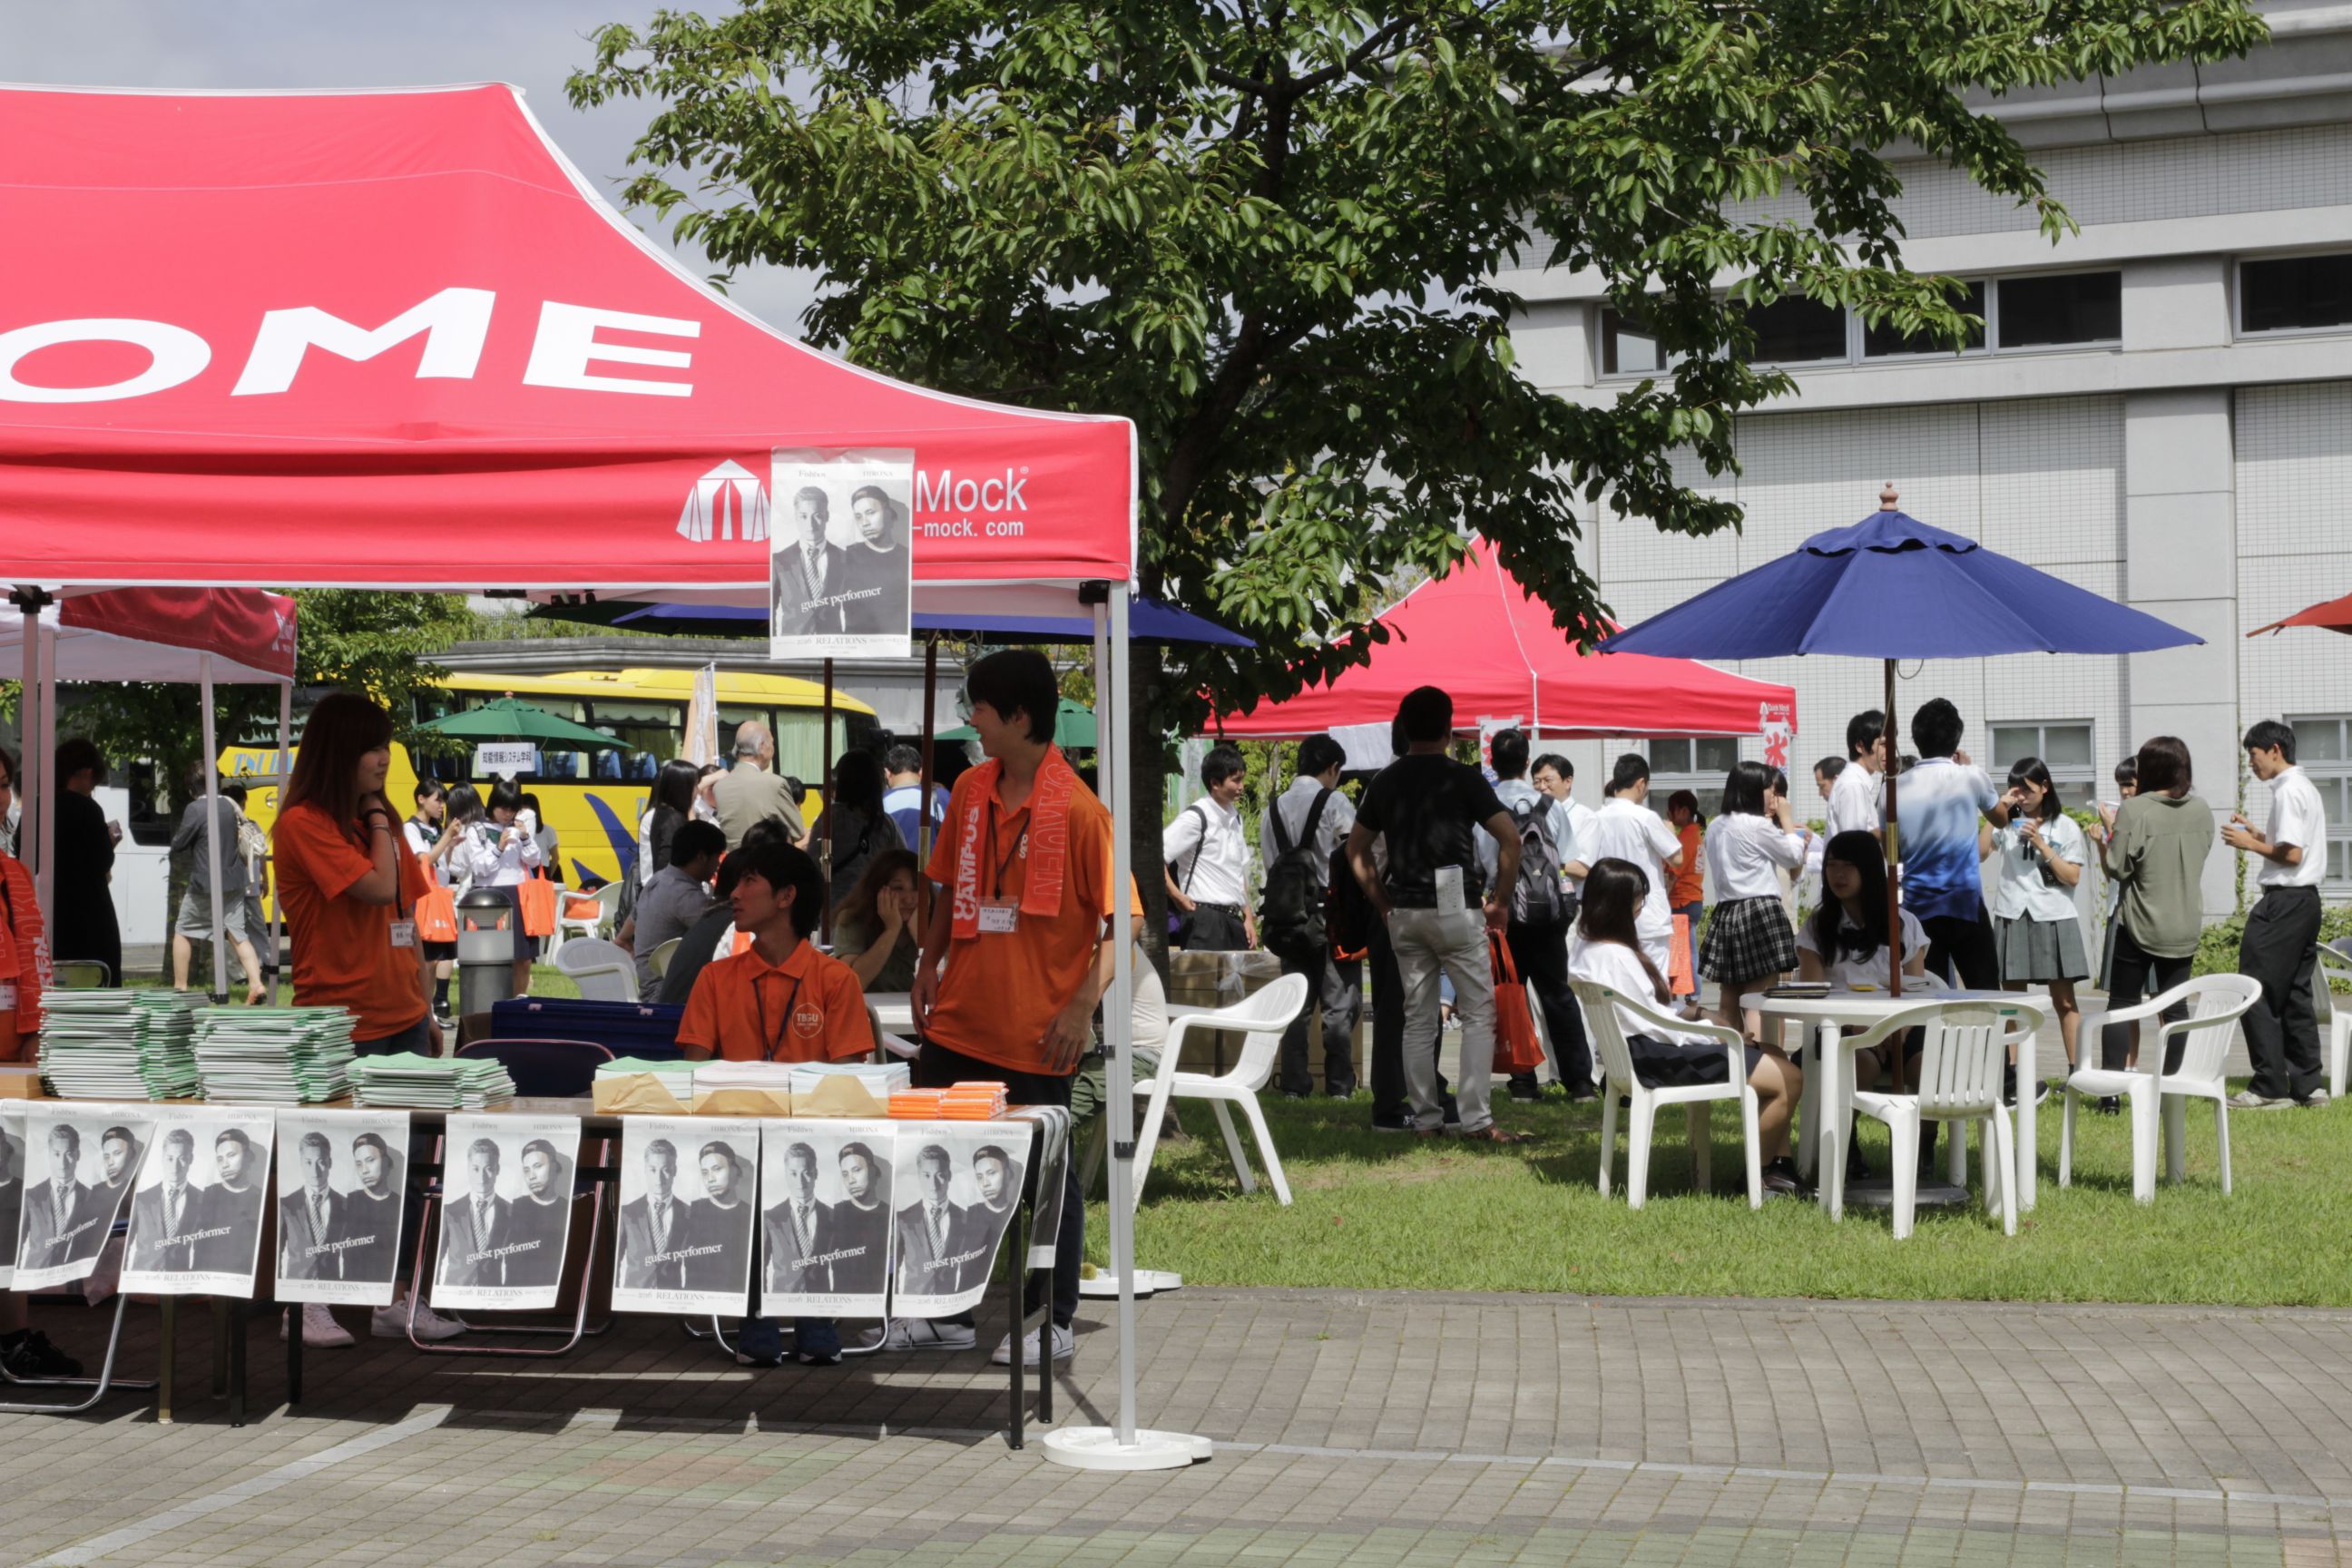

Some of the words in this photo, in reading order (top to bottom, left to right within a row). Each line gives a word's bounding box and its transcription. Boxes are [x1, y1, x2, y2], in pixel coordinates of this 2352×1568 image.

[801, 595, 829, 612] guest
[830, 587, 882, 606] performer
[817, 637, 867, 645] RELATIONS
[45, 1232, 66, 1248] guest
[66, 1217, 99, 1240] performer
[154, 1234, 181, 1250] guest
[183, 1227, 231, 1245] performer
[305, 1243, 330, 1258] guest
[331, 1235, 376, 1253] performer
[466, 1250, 493, 1265] guest
[494, 1240, 541, 1259] performer
[644, 1252, 671, 1267] guest
[672, 1244, 722, 1262] performer
[791, 1256, 818, 1270] guest
[819, 1246, 867, 1265] performer
[923, 1258, 949, 1272] guest
[950, 1244, 987, 1268] performer
[164, 1274, 211, 1282] RELATIONS
[318, 1283, 360, 1291] RELATIONS
[477, 1289, 523, 1297] RELATIONS
[656, 1291, 705, 1300] RELATIONS
[807, 1295, 852, 1304] RELATIONS
